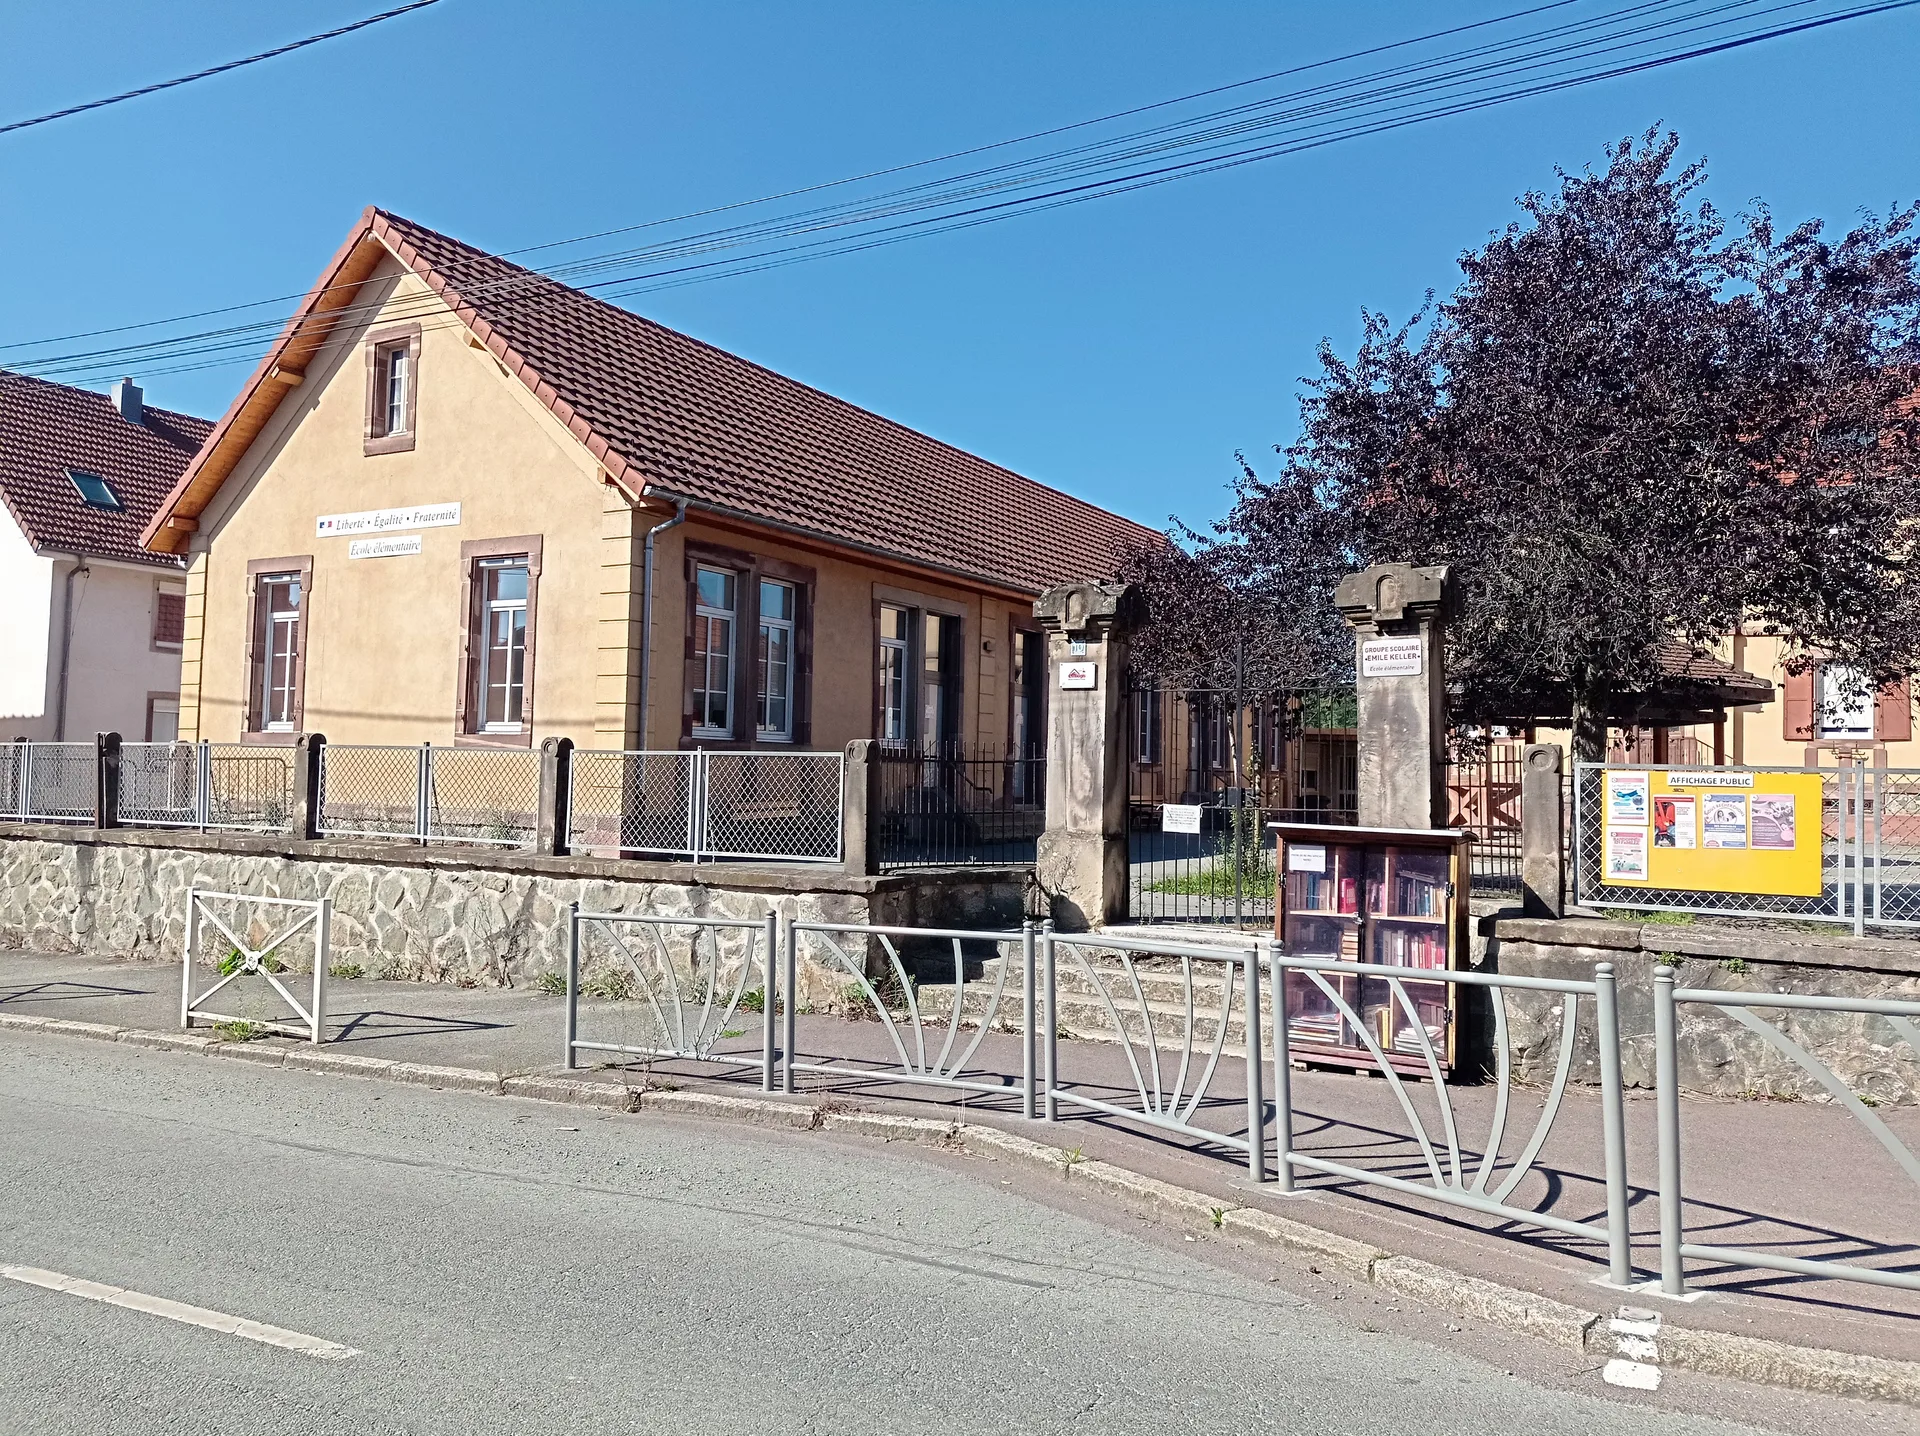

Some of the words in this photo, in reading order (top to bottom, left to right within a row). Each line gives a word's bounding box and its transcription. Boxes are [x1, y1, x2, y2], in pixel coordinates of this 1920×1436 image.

[336, 517, 365, 530] Liberté
[374, 513, 403, 529] Égalité
[413, 508, 457, 522] Fraternité
[350, 542, 371, 555] École
[373, 540, 420, 553] élémentaire
